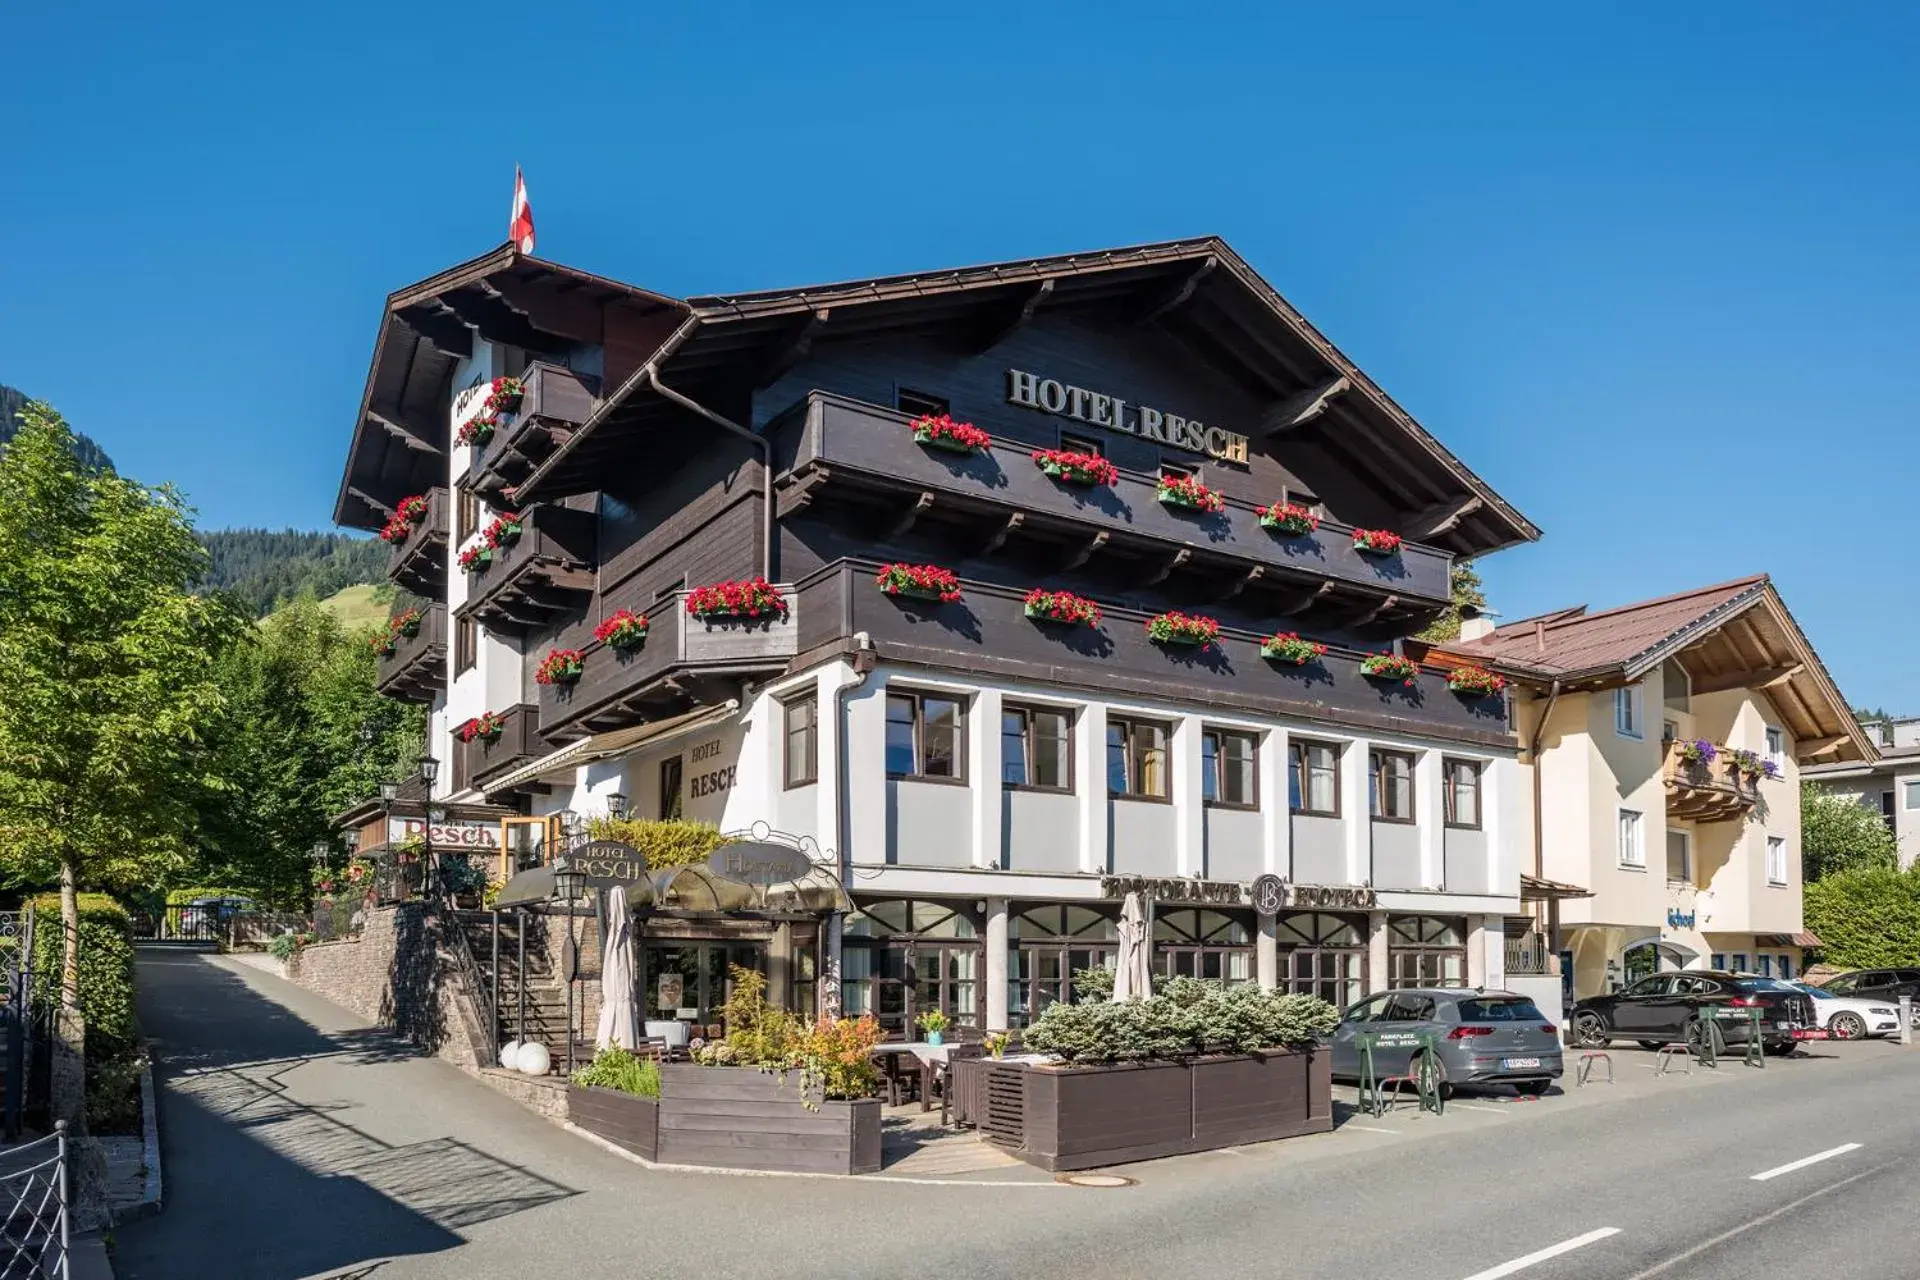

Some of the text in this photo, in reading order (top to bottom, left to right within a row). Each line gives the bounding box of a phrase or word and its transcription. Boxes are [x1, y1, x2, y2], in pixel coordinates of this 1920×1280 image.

[1007, 368, 1250, 466] HOTEL RESCH
[692, 739, 721, 763] HOTEL
[691, 764, 738, 799] RESCH
[575, 858, 640, 880] RESCH
